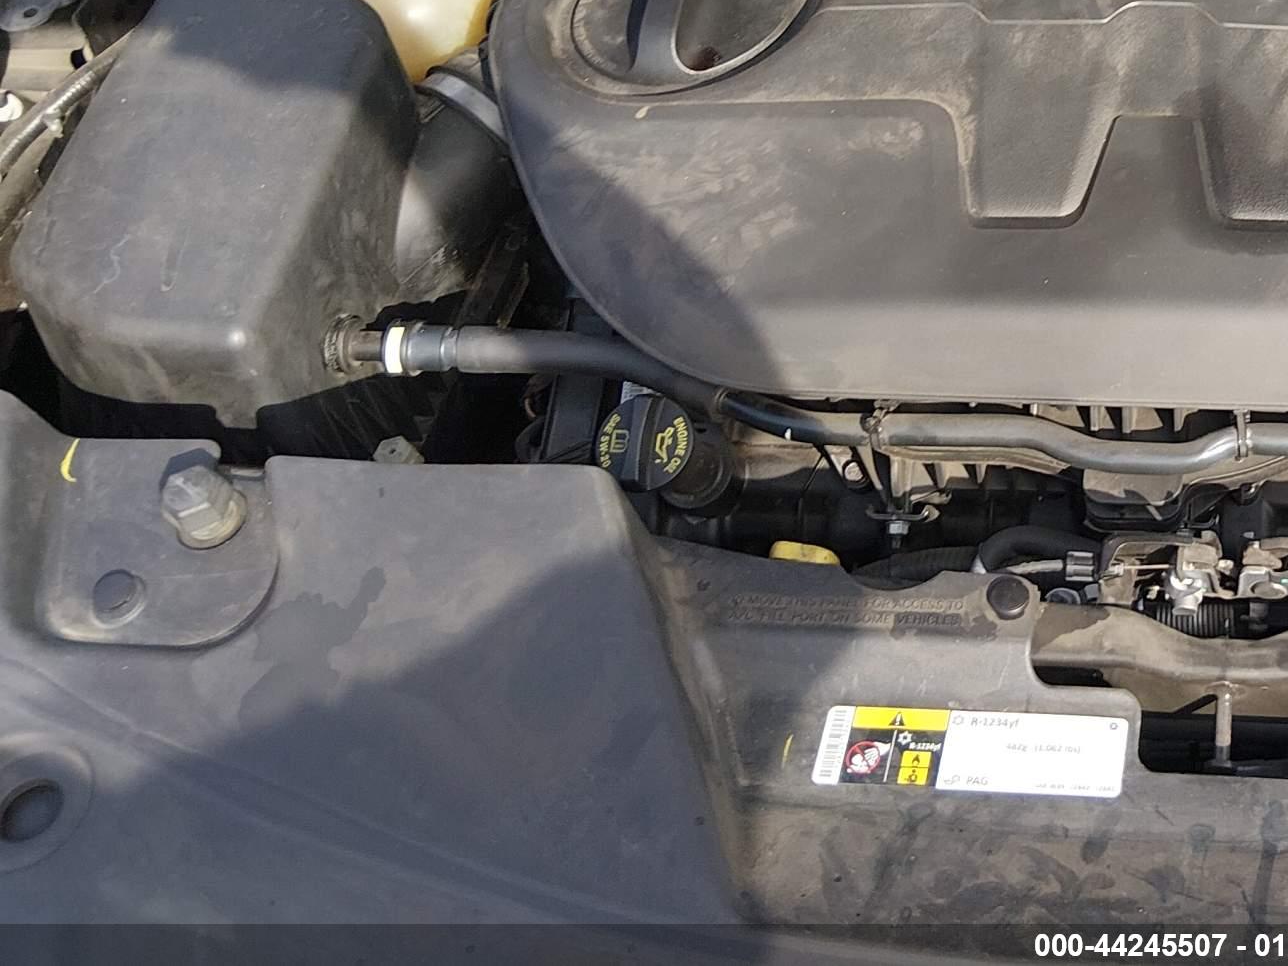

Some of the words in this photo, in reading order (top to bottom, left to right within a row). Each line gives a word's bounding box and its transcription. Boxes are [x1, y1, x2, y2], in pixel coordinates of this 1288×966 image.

[673, 416, 688, 457] ENGINE
[663, 457, 682, 473] OIL
[863, 597, 891, 611] FOR
[893, 598, 945, 613] ACCESS
[947, 600, 964, 613] TO
[897, 614, 963, 628] VEHICLES
[971, 716, 1020, 730] R-1234yf
[966, 775, 989, 787] PAG
